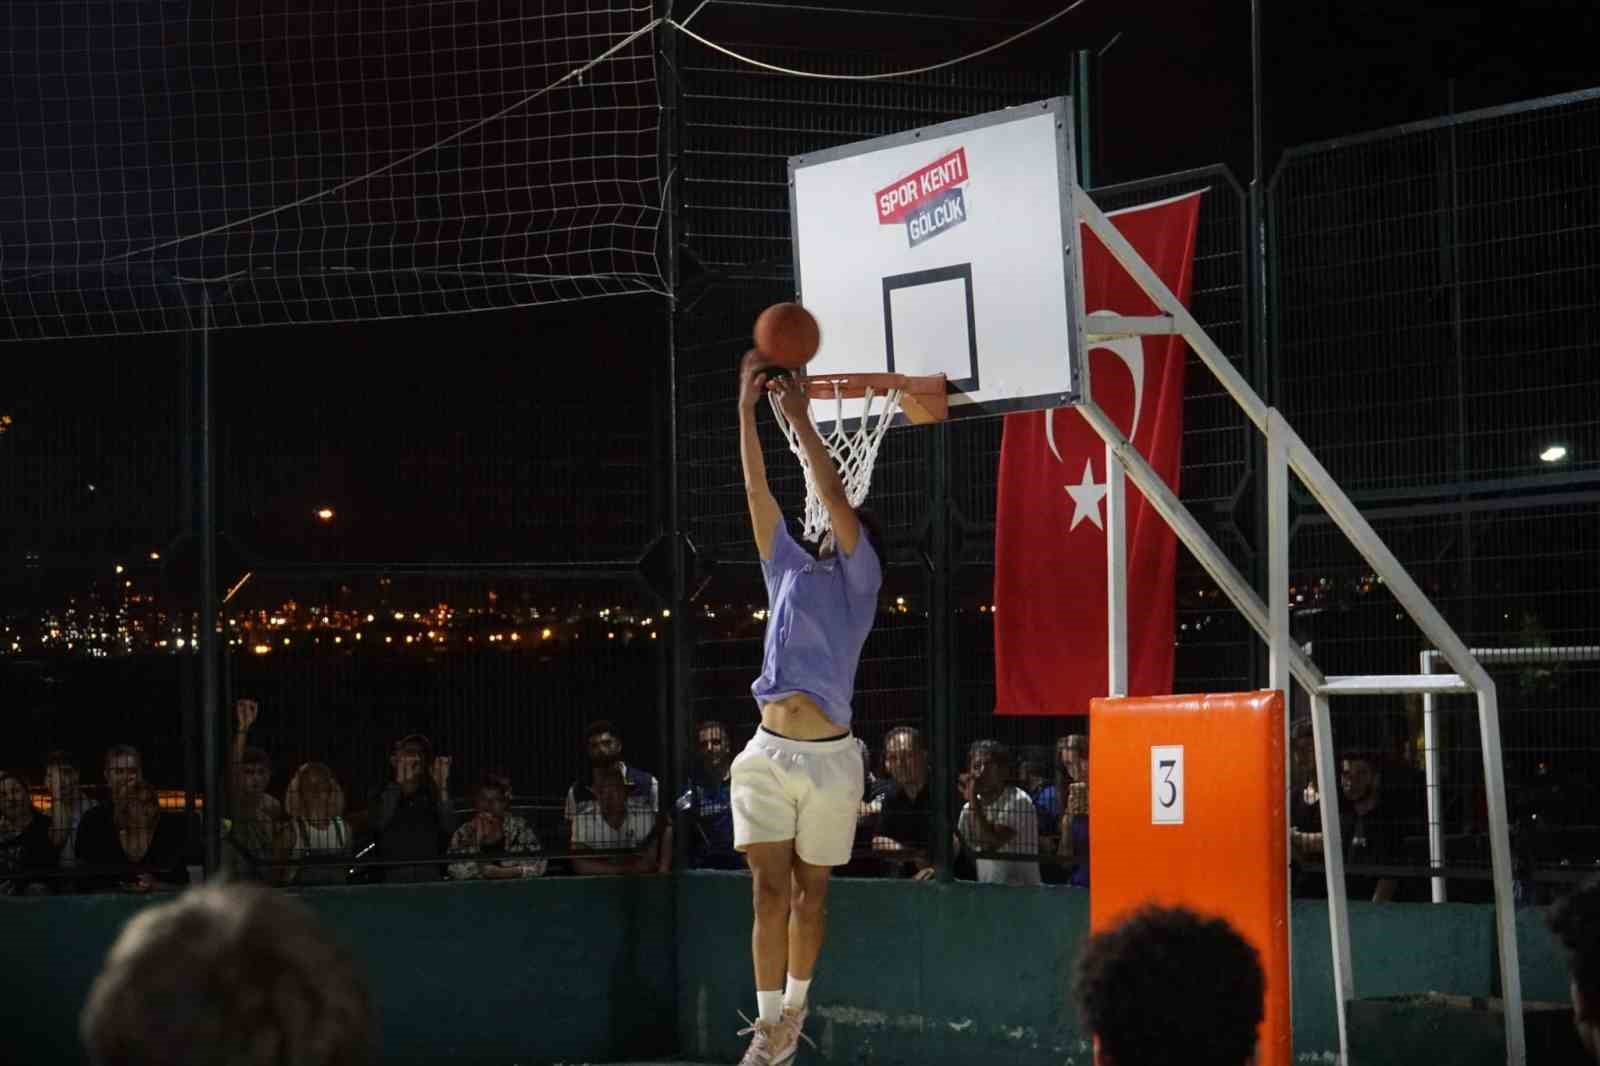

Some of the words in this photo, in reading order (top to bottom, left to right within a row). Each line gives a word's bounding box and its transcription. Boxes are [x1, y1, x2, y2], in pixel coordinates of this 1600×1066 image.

[880, 179, 919, 216] SPOR
[920, 153, 963, 196] KENTİ
[909, 196, 963, 240] GÖLCÜK
[1158, 760, 1177, 808] 3
